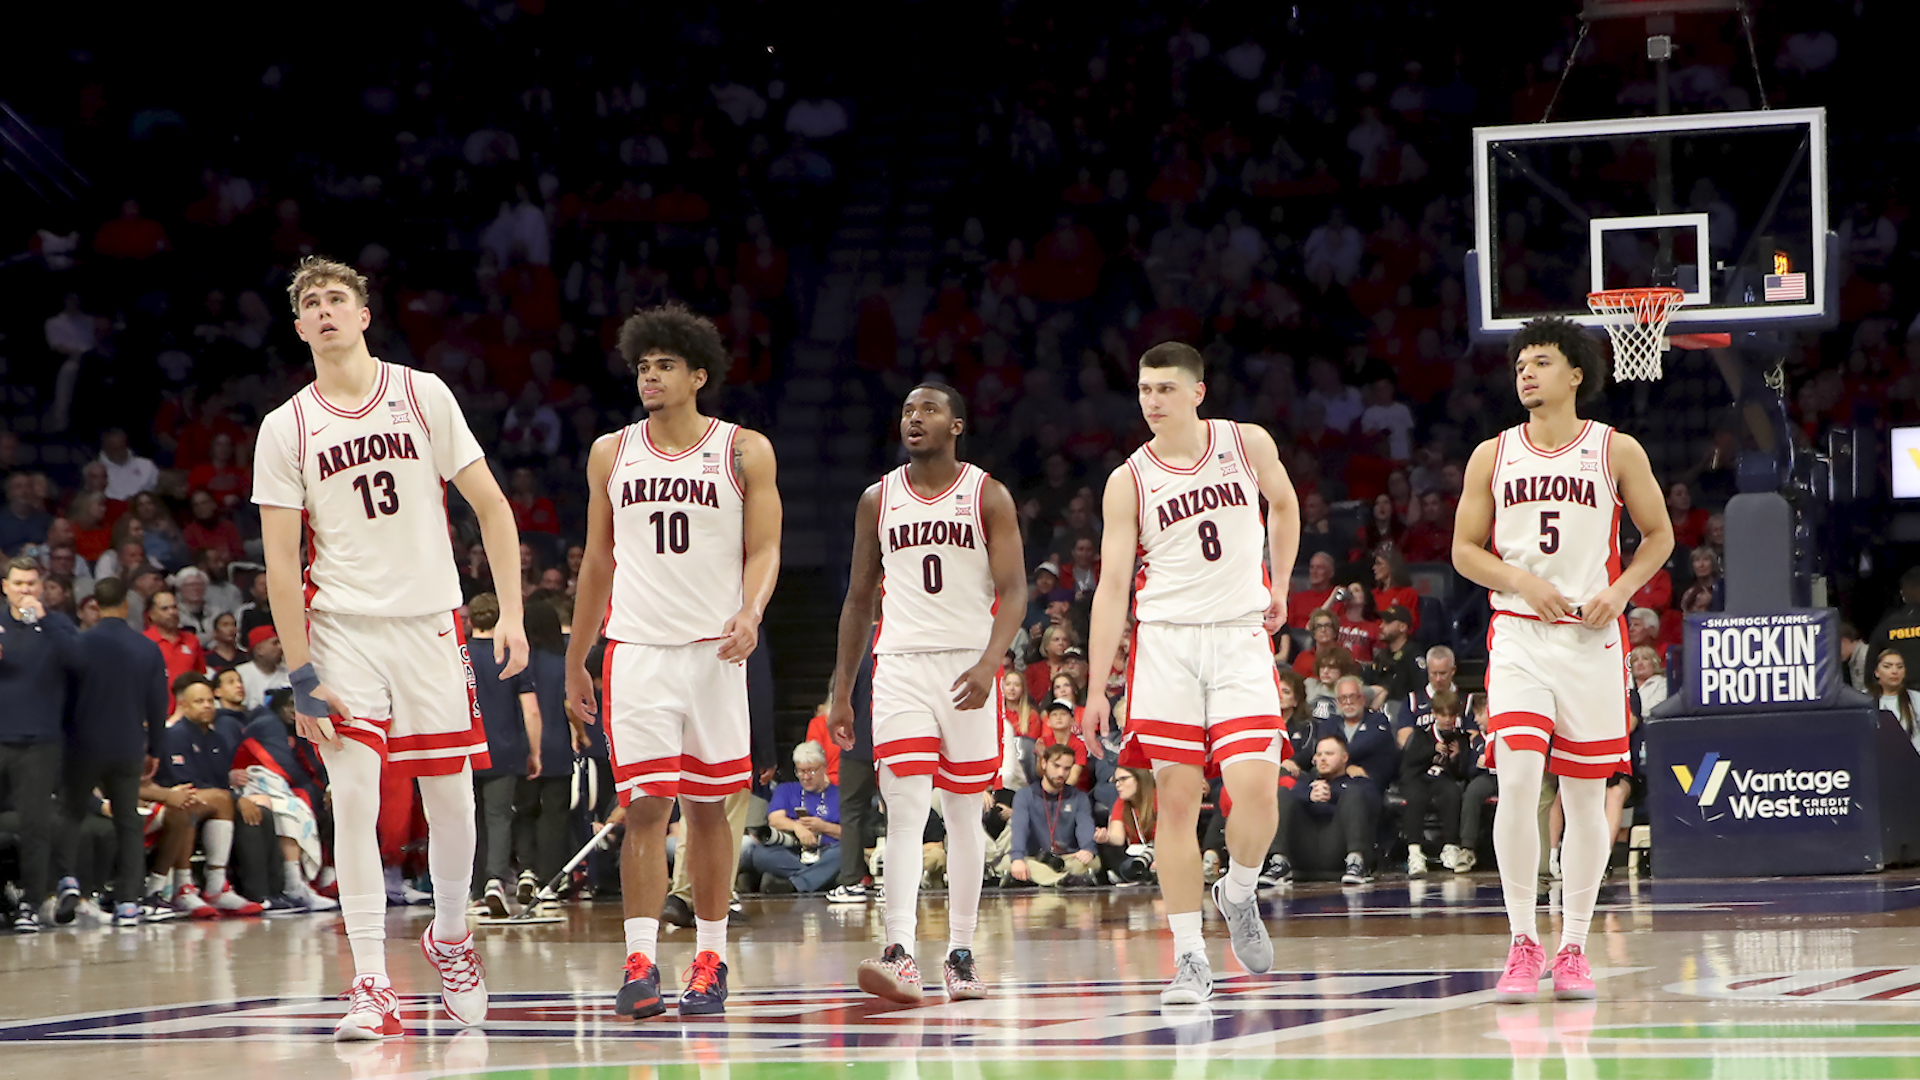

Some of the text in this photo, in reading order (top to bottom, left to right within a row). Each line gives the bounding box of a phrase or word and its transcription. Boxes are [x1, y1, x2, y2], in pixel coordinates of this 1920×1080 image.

[316, 433, 419, 481] ARIZONA
[352, 471, 399, 519] 13
[621, 477, 720, 509] ARIZONA
[1156, 482, 1248, 532] ARIZONA
[1504, 475, 1597, 509] ARIZONA
[649, 511, 689, 554] 10
[889, 520, 976, 553] ARIZONA
[1198, 520, 1222, 562] 8
[1539, 511, 1560, 554] 5
[922, 554, 943, 594] 0
[1701, 624, 1821, 668] ROCKIN'
[459, 644, 481, 719] CATS
[1701, 665, 1815, 705] PROTEIN
[1730, 768, 1850, 795] Vantage
[1728, 794, 1801, 819] West
[1802, 797, 1850, 807] CREDIT
[1806, 806, 1848, 817] UNION
